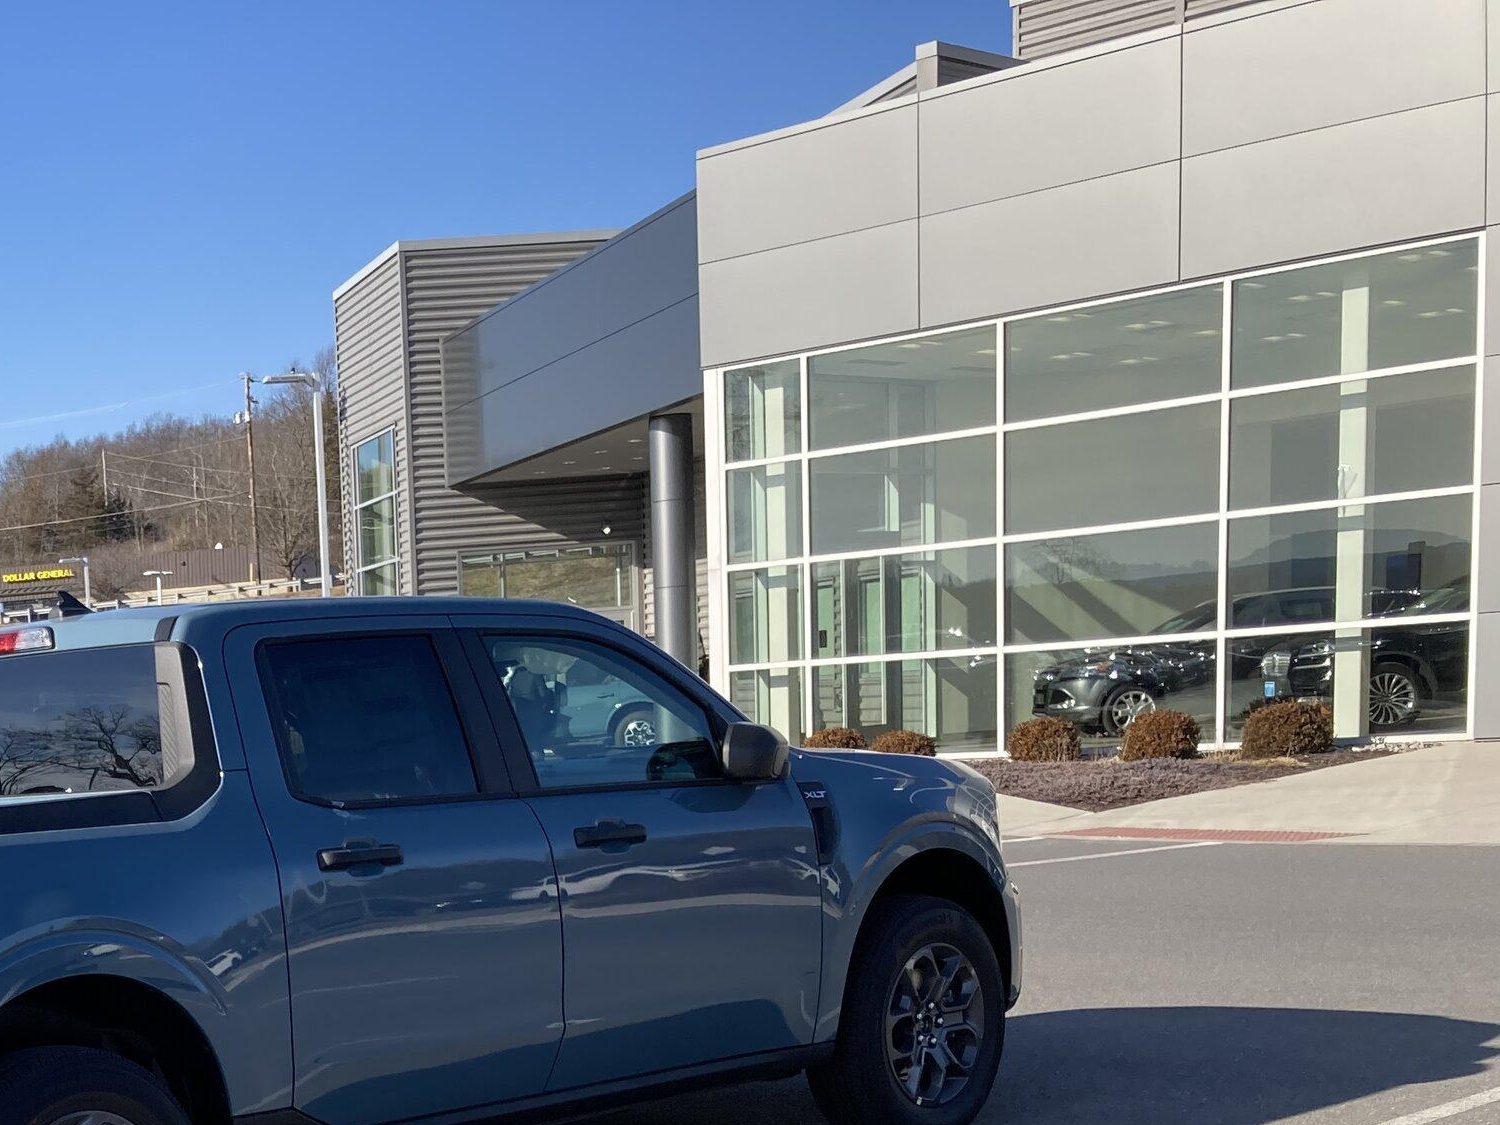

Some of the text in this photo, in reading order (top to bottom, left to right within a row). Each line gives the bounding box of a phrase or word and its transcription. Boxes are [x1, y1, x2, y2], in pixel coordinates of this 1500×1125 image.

[2, 569, 75, 583] DOLLAR GENERAL
[803, 790, 827, 799] XLT
